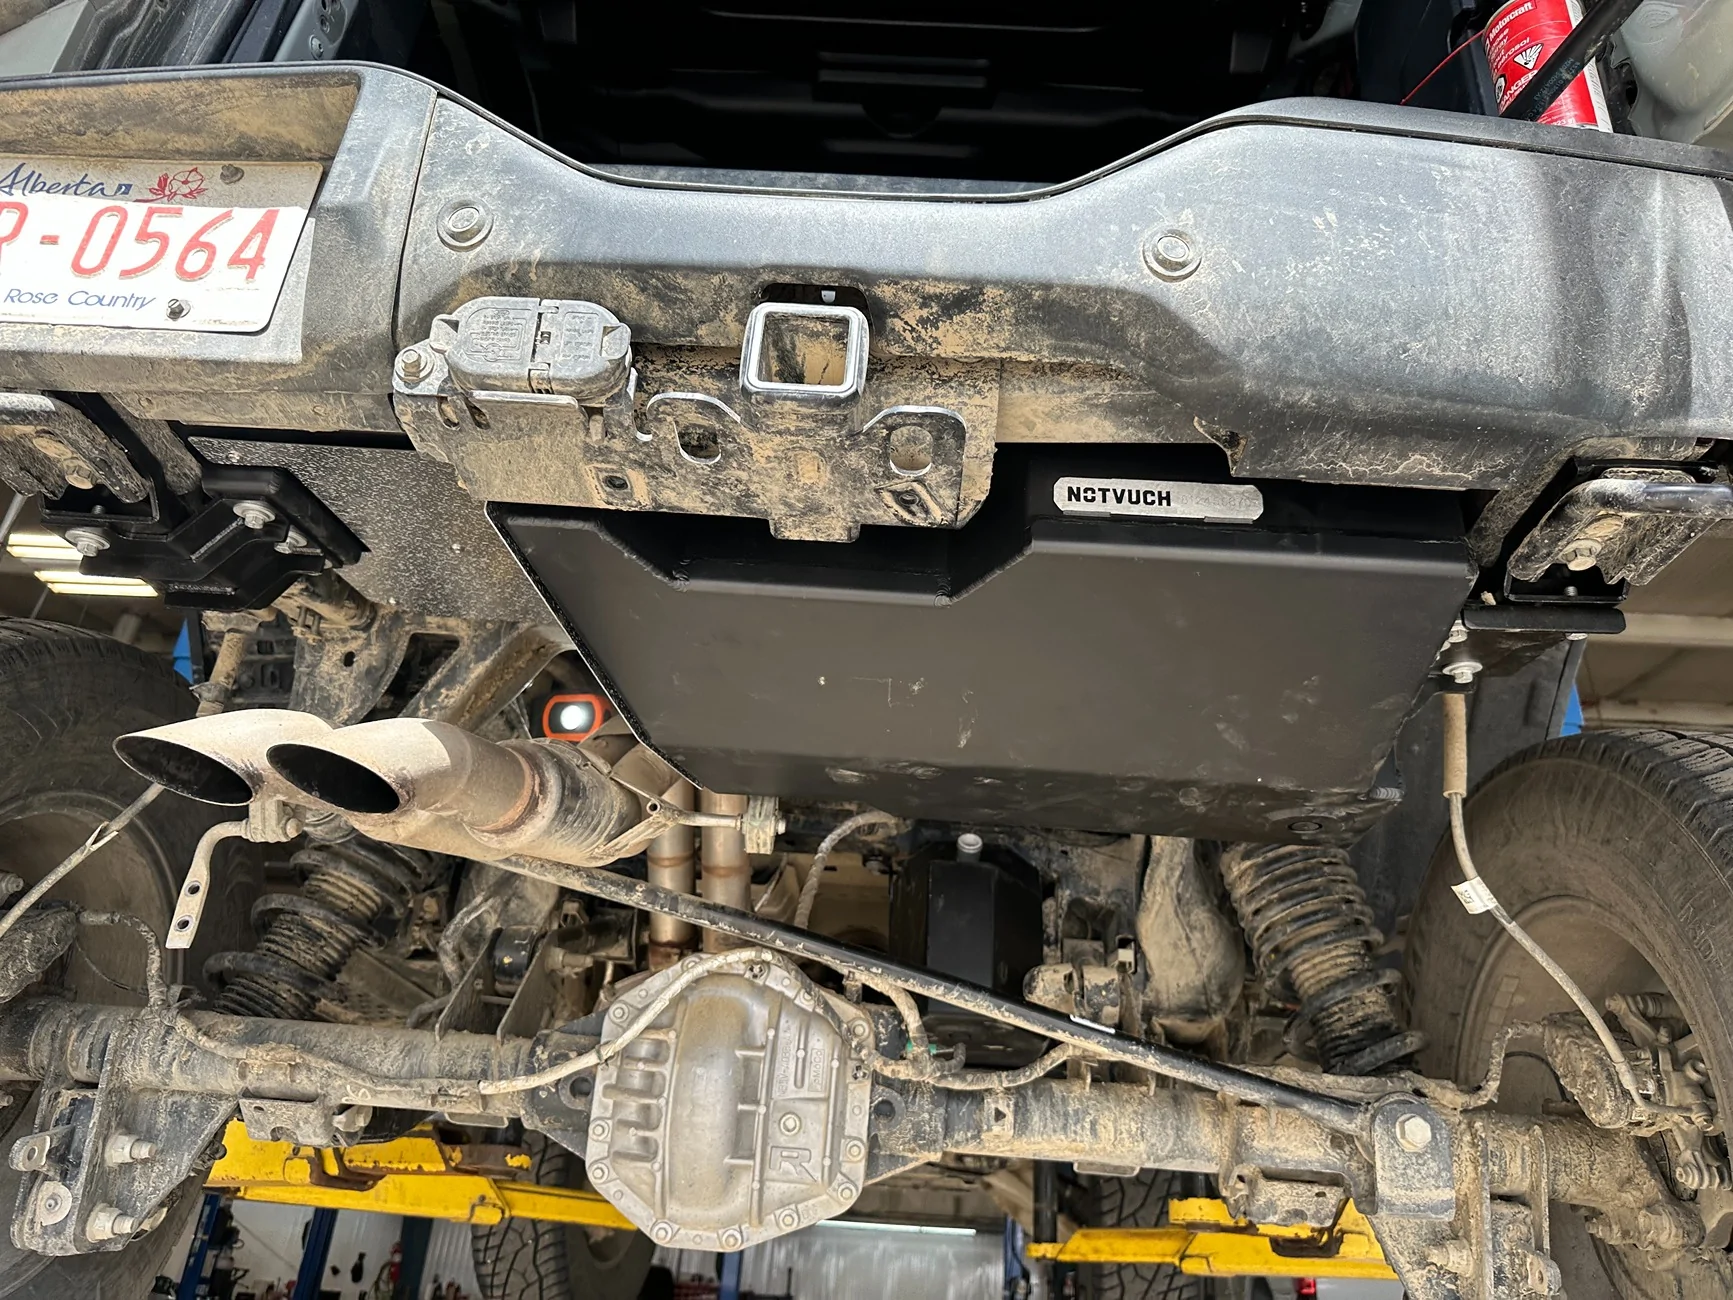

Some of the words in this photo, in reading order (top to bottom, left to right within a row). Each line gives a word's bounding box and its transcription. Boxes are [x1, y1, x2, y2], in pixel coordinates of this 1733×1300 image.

[1490, 2, 1532, 42] Motorcraft
[0, 163, 114, 197] Alberta
[5, 288, 58, 306] Rose
[68, 290, 156, 311] Country
[1067, 486, 1171, 506] NOTVUCH
[769, 1146, 820, 1182] R
